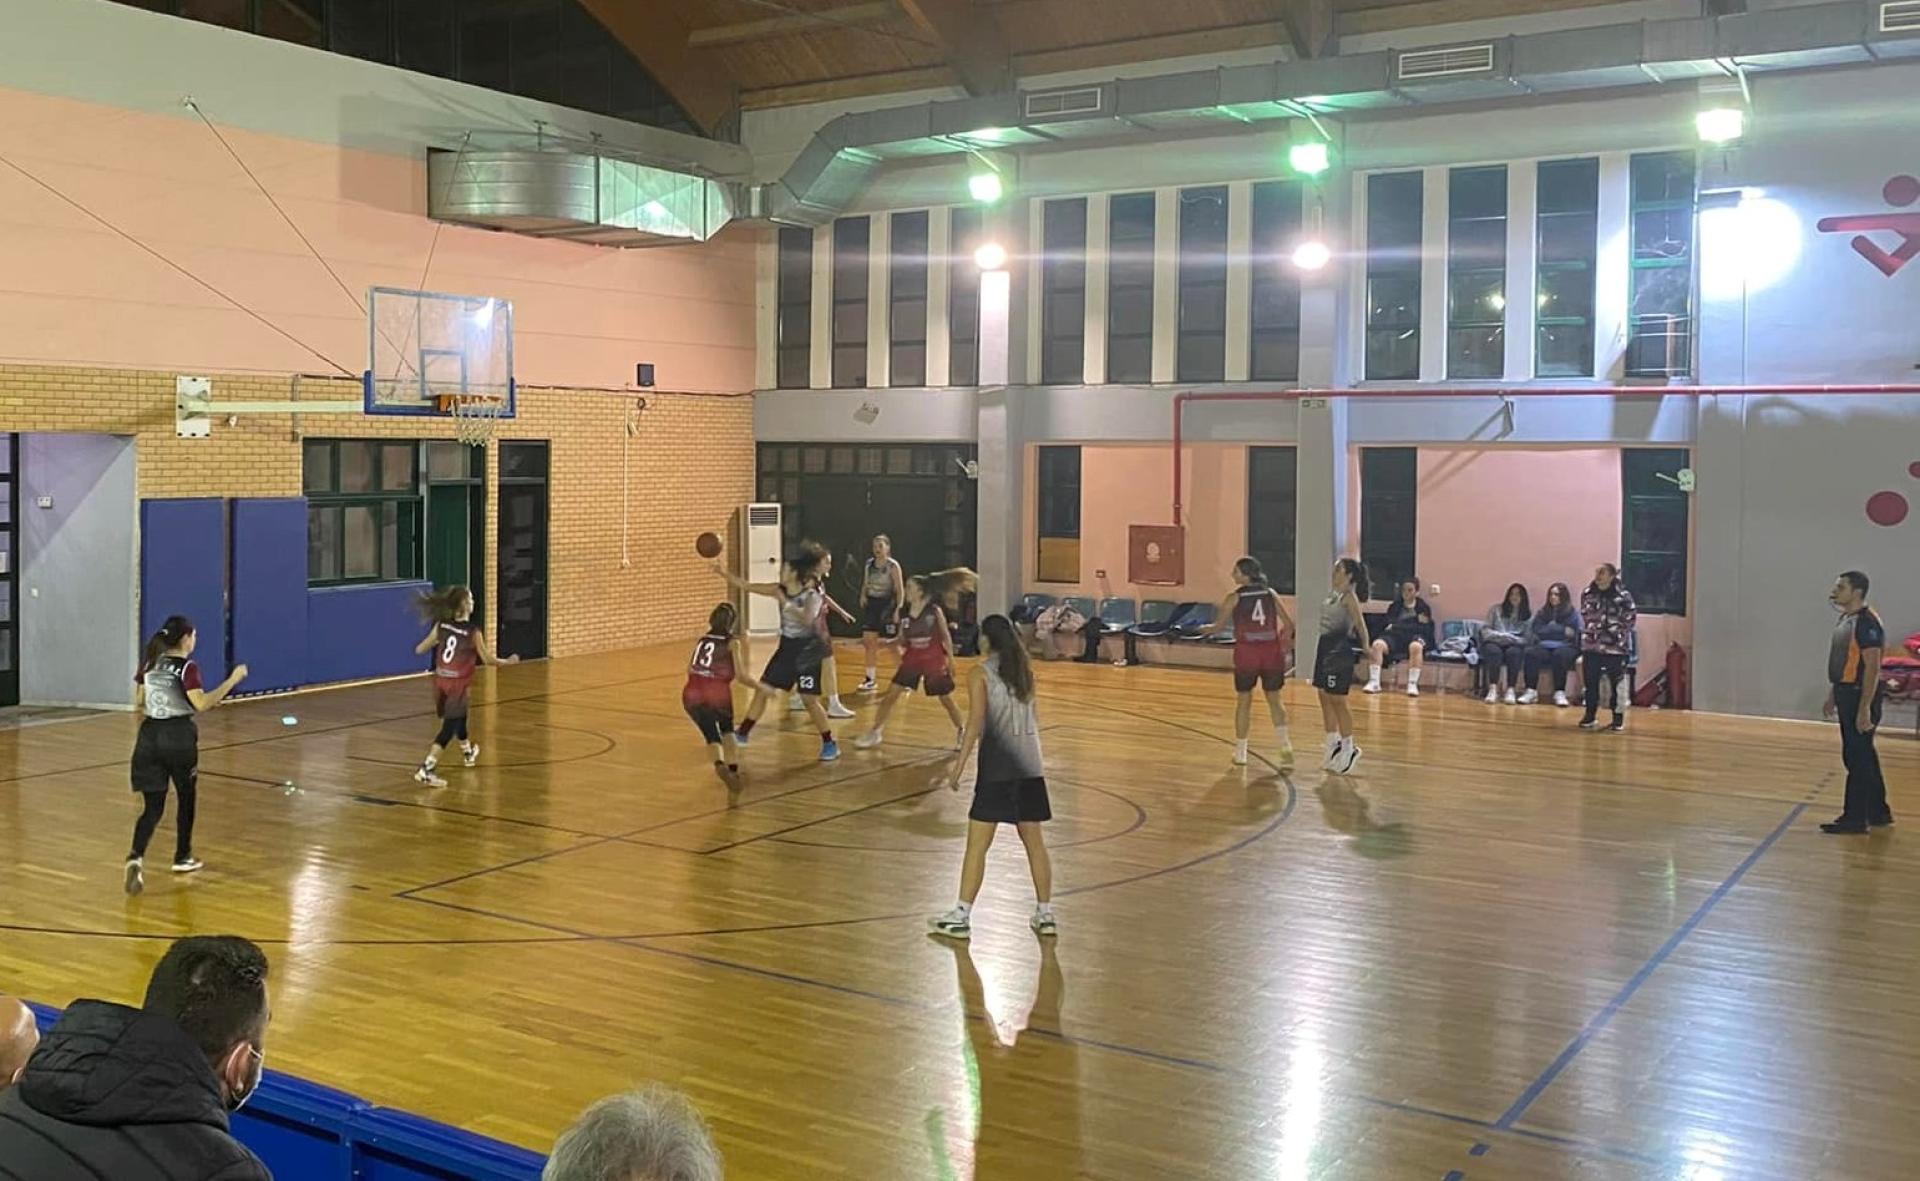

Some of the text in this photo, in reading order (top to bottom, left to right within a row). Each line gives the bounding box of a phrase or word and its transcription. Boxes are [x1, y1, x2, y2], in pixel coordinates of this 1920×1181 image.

[1252, 599, 1266, 626] 4
[443, 635, 457, 664] 8
[692, 641, 715, 667] 13
[1328, 675, 1337, 688] 5
